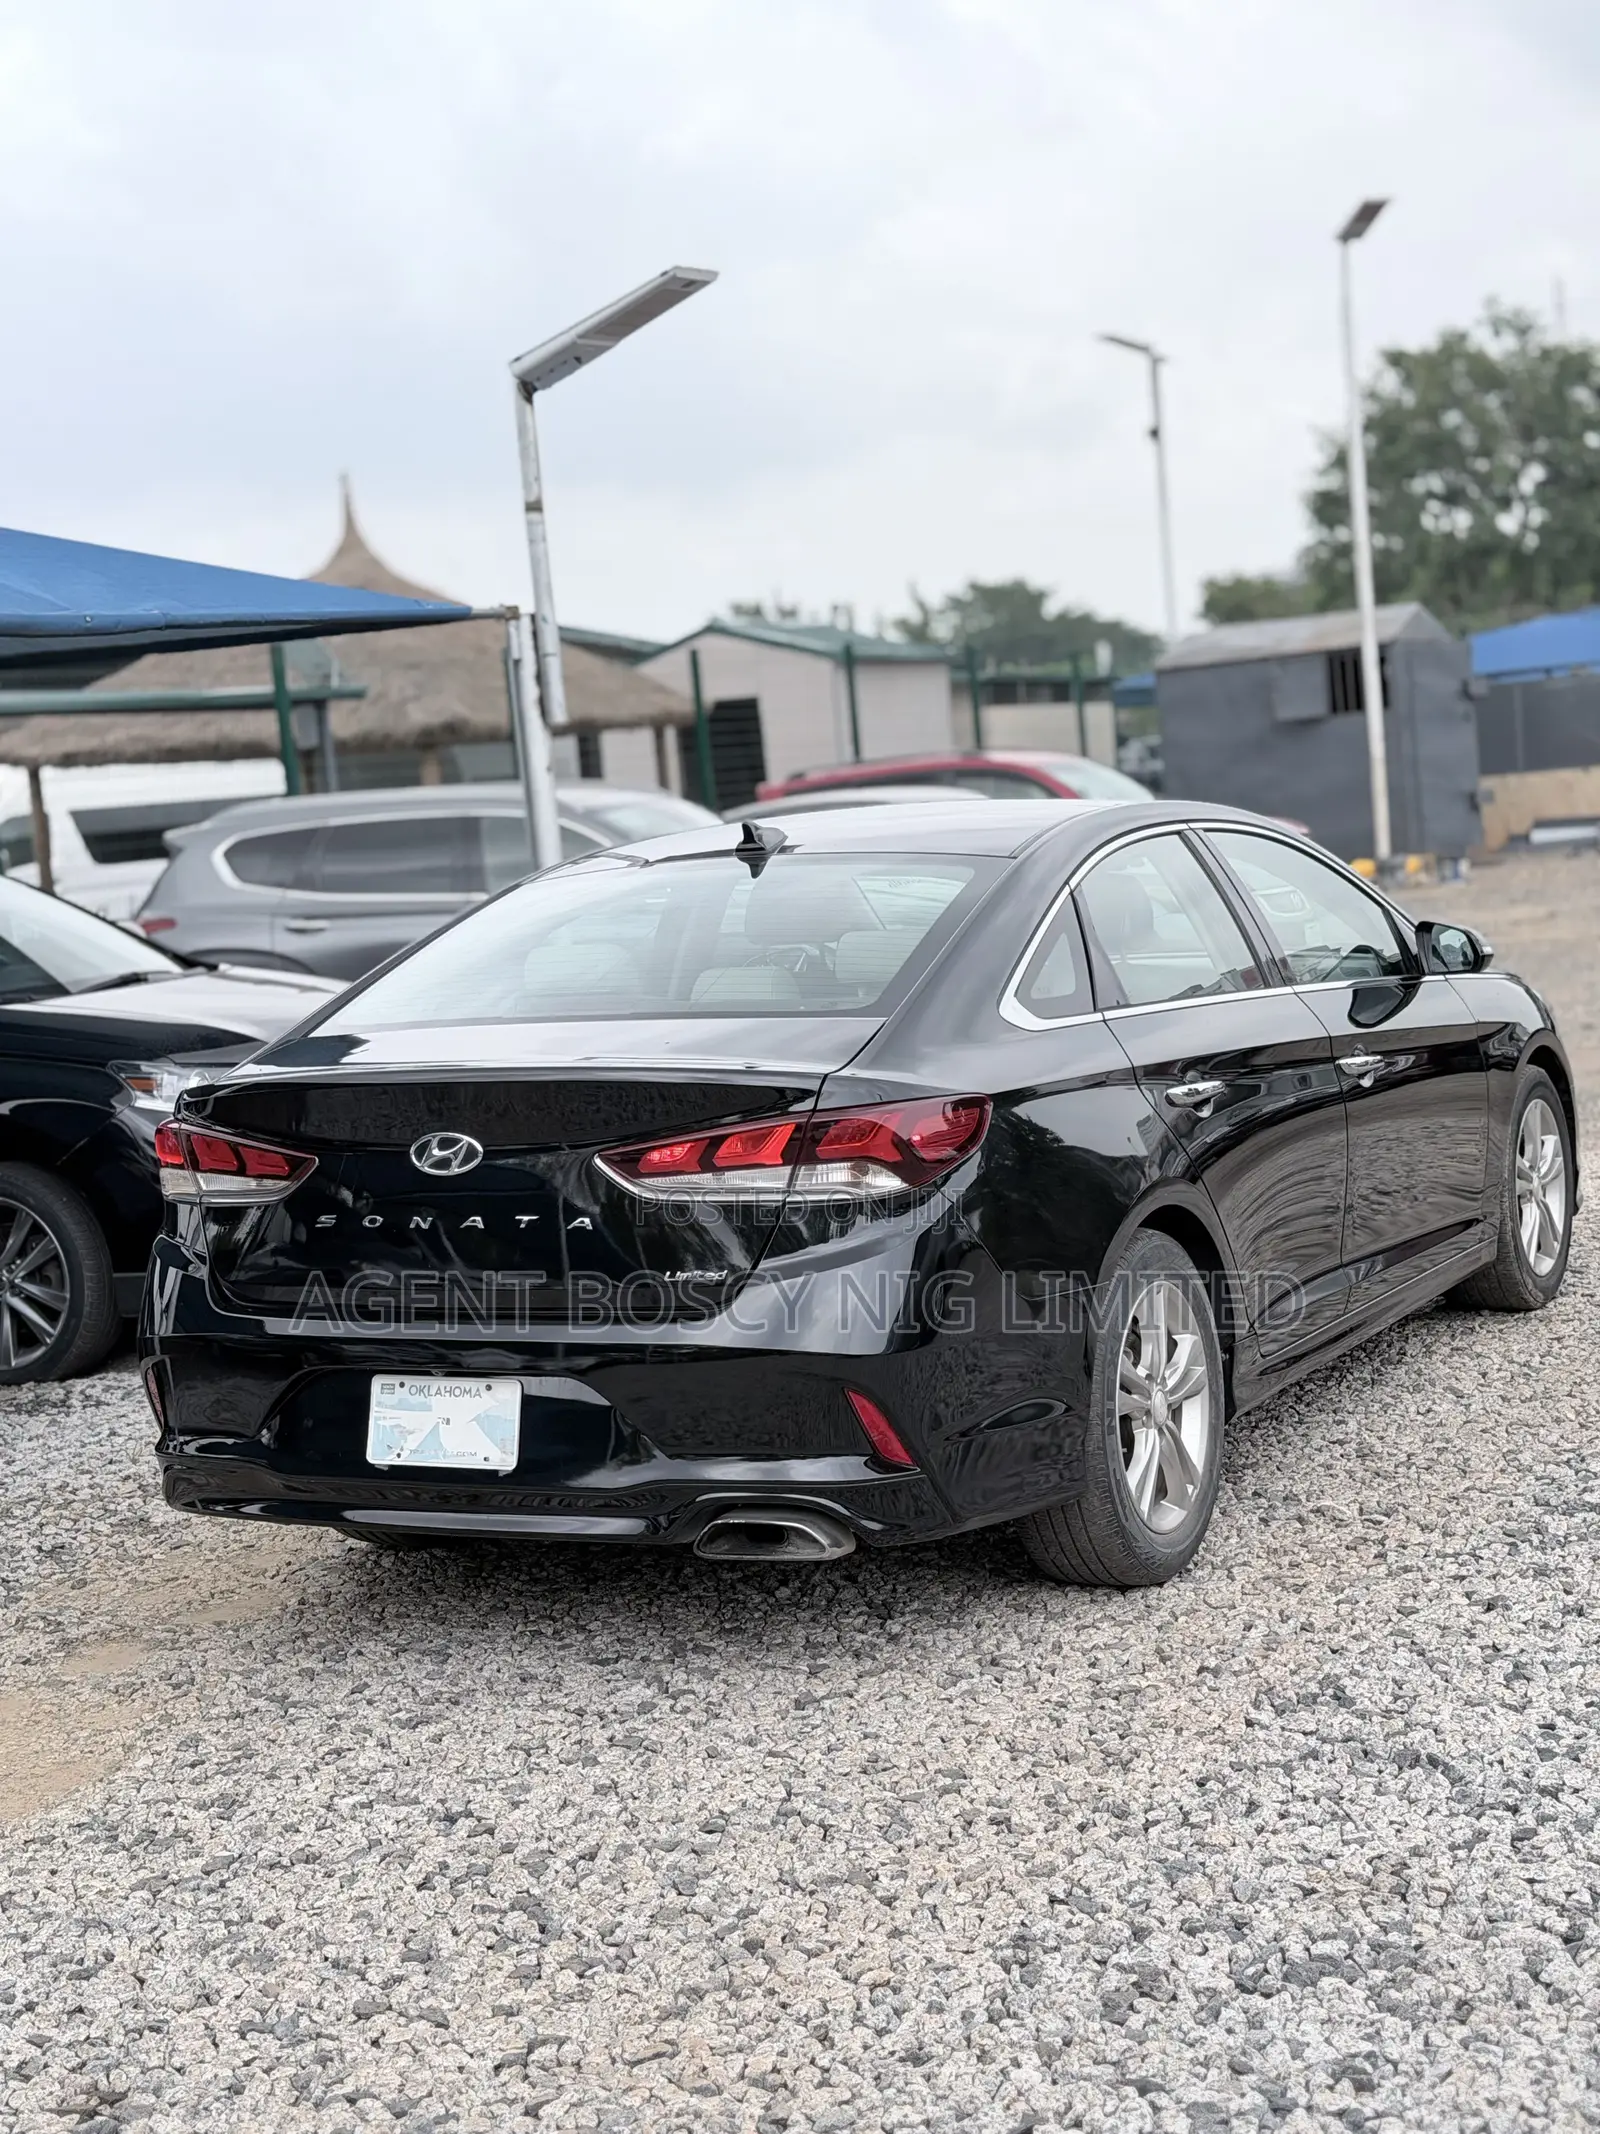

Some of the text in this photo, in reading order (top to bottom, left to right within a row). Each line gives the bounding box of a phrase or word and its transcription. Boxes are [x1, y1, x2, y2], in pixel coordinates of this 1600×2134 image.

[314, 1214, 595, 1231] SONATA
[664, 1269, 728, 1281] Limited
[408, 1384, 482, 1399] OKLAHOMA
